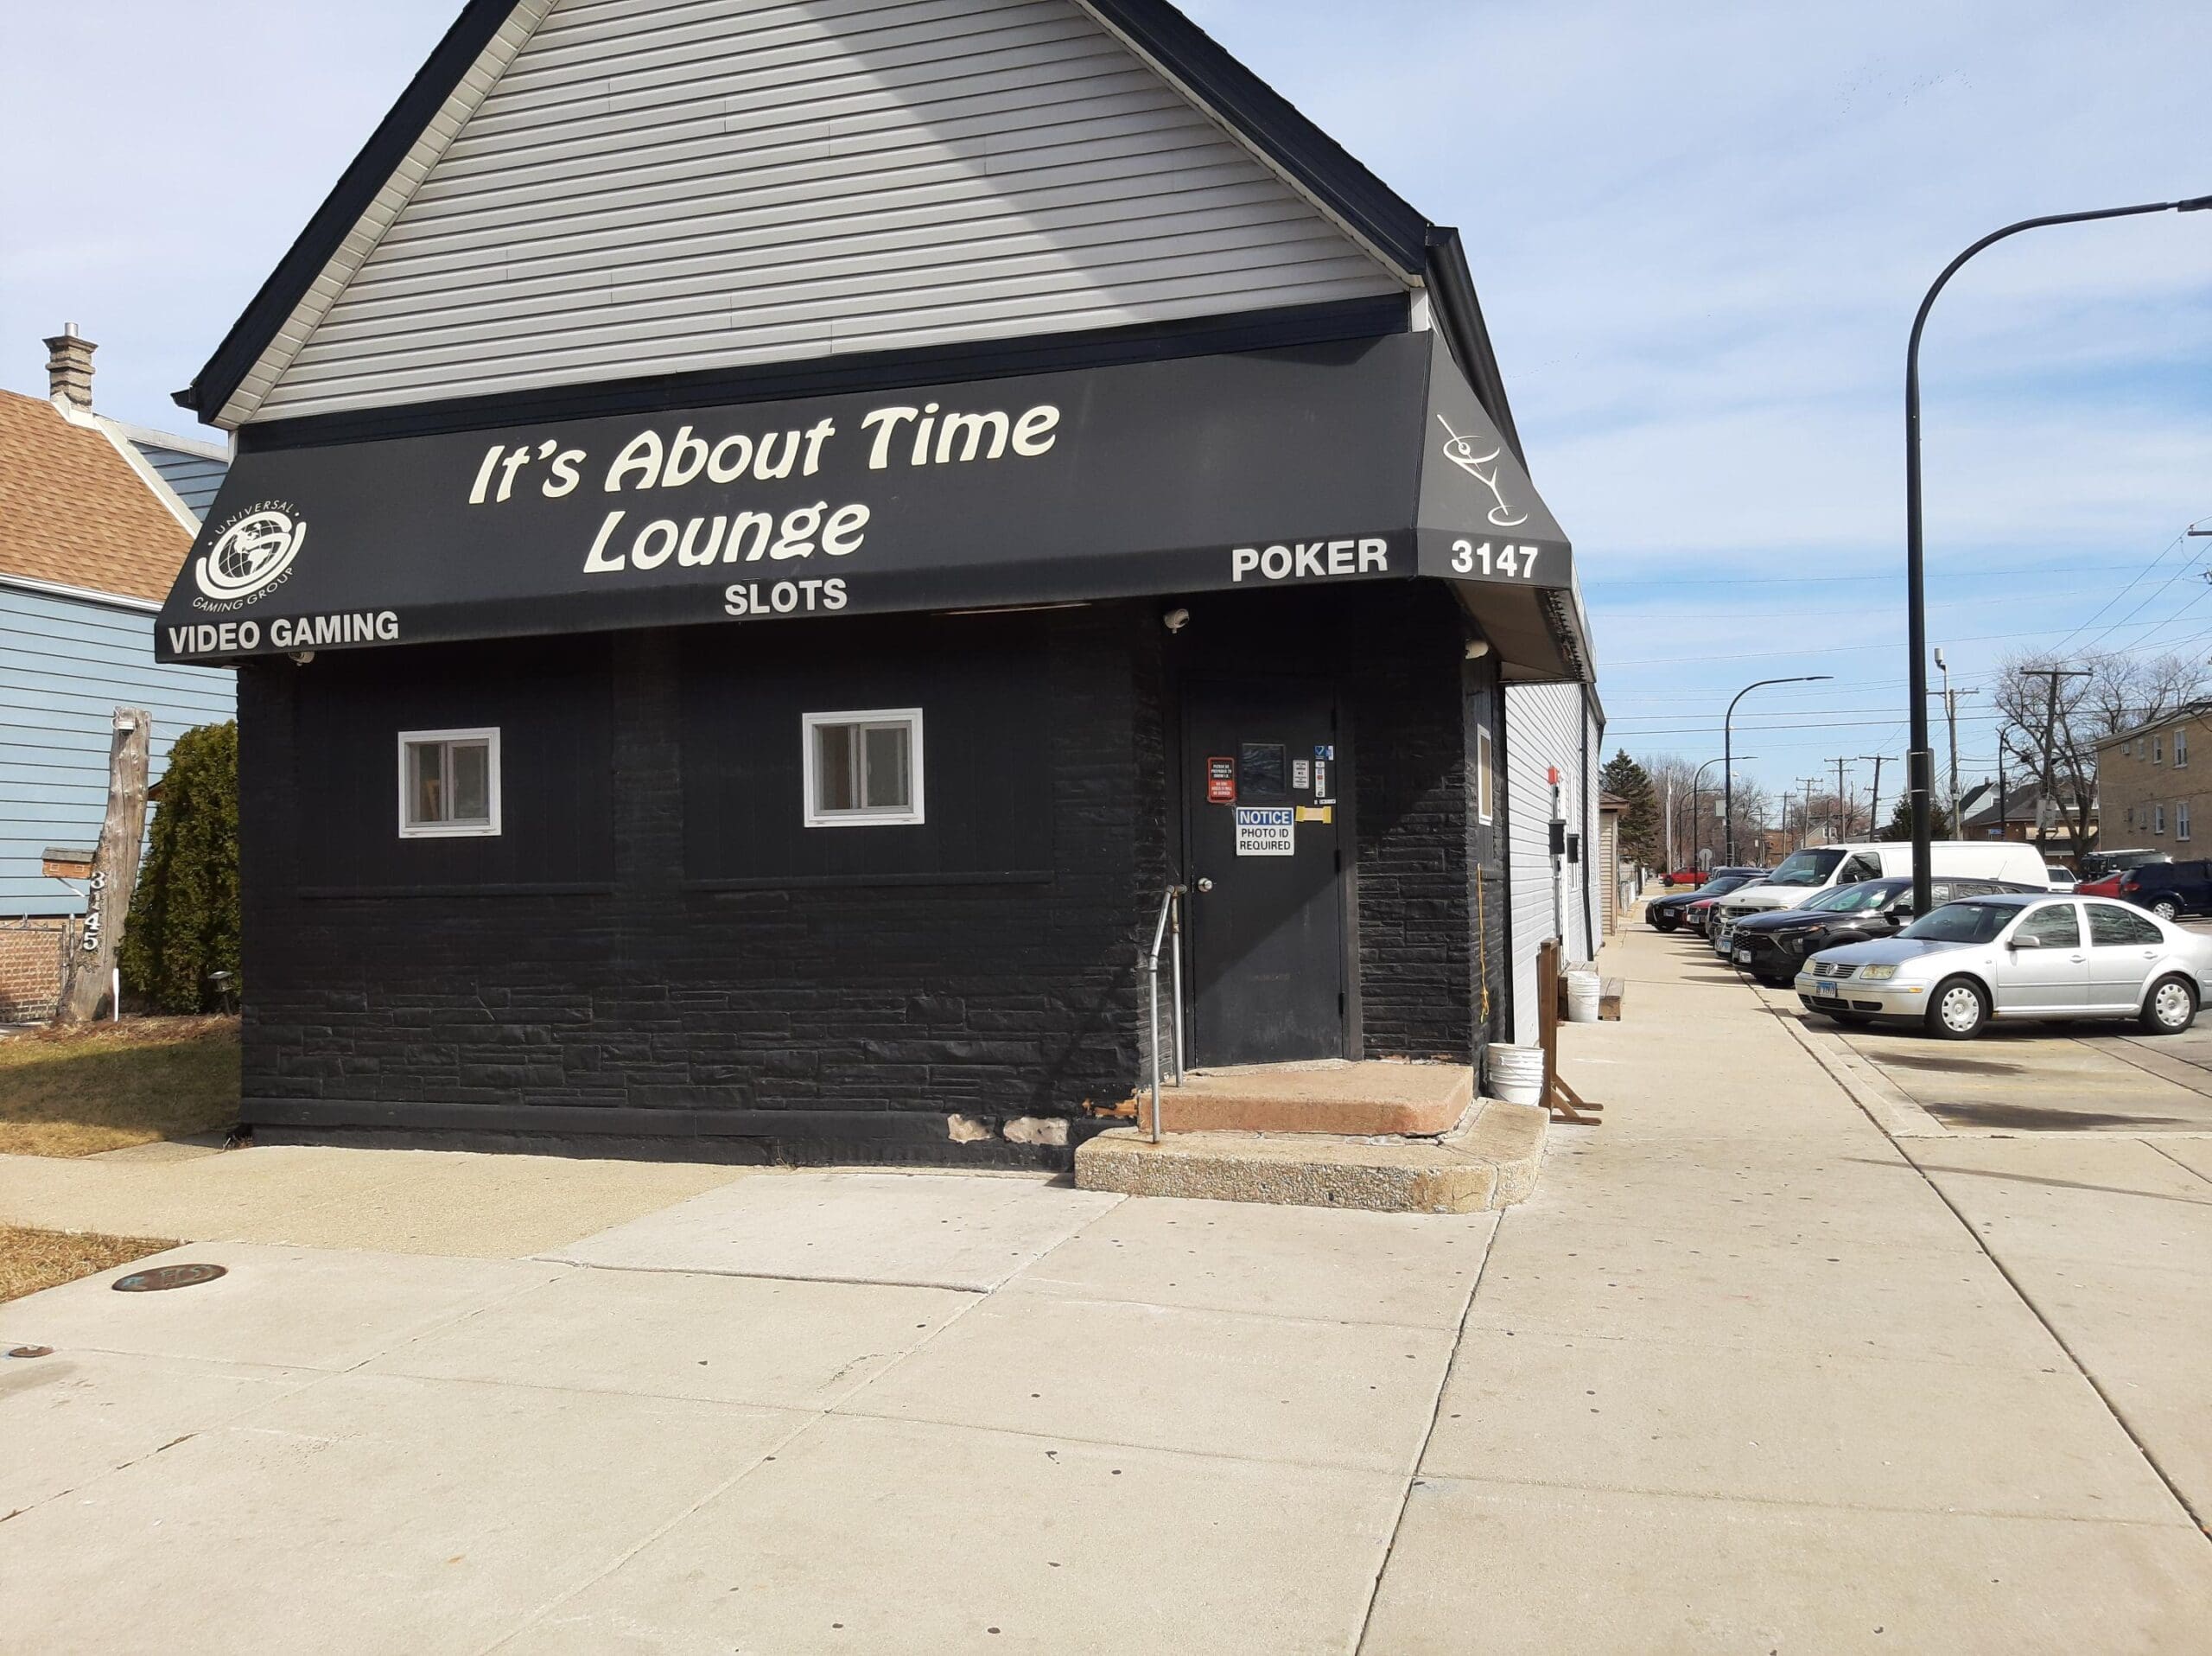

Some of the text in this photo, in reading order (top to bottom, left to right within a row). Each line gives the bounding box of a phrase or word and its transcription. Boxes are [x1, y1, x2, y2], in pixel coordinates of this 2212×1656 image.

[468, 401, 1060, 505] It's About Time
[214, 500, 294, 535] UNIVERSAL
[582, 500, 871, 574] Lounge
[1232, 538, 1389, 583] POKER
[1451, 539, 1539, 579] 3147
[193, 567, 294, 613] GAMING GROUP
[724, 577, 848, 615] SLOTS
[168, 610, 399, 654] VIDEO GAMING
[1240, 811, 1290, 825] NOTICE
[1241, 828, 1289, 838] PHOTO ID
[1239, 840, 1291, 850] REQUIRED
[83, 870, 105, 951] 3145
